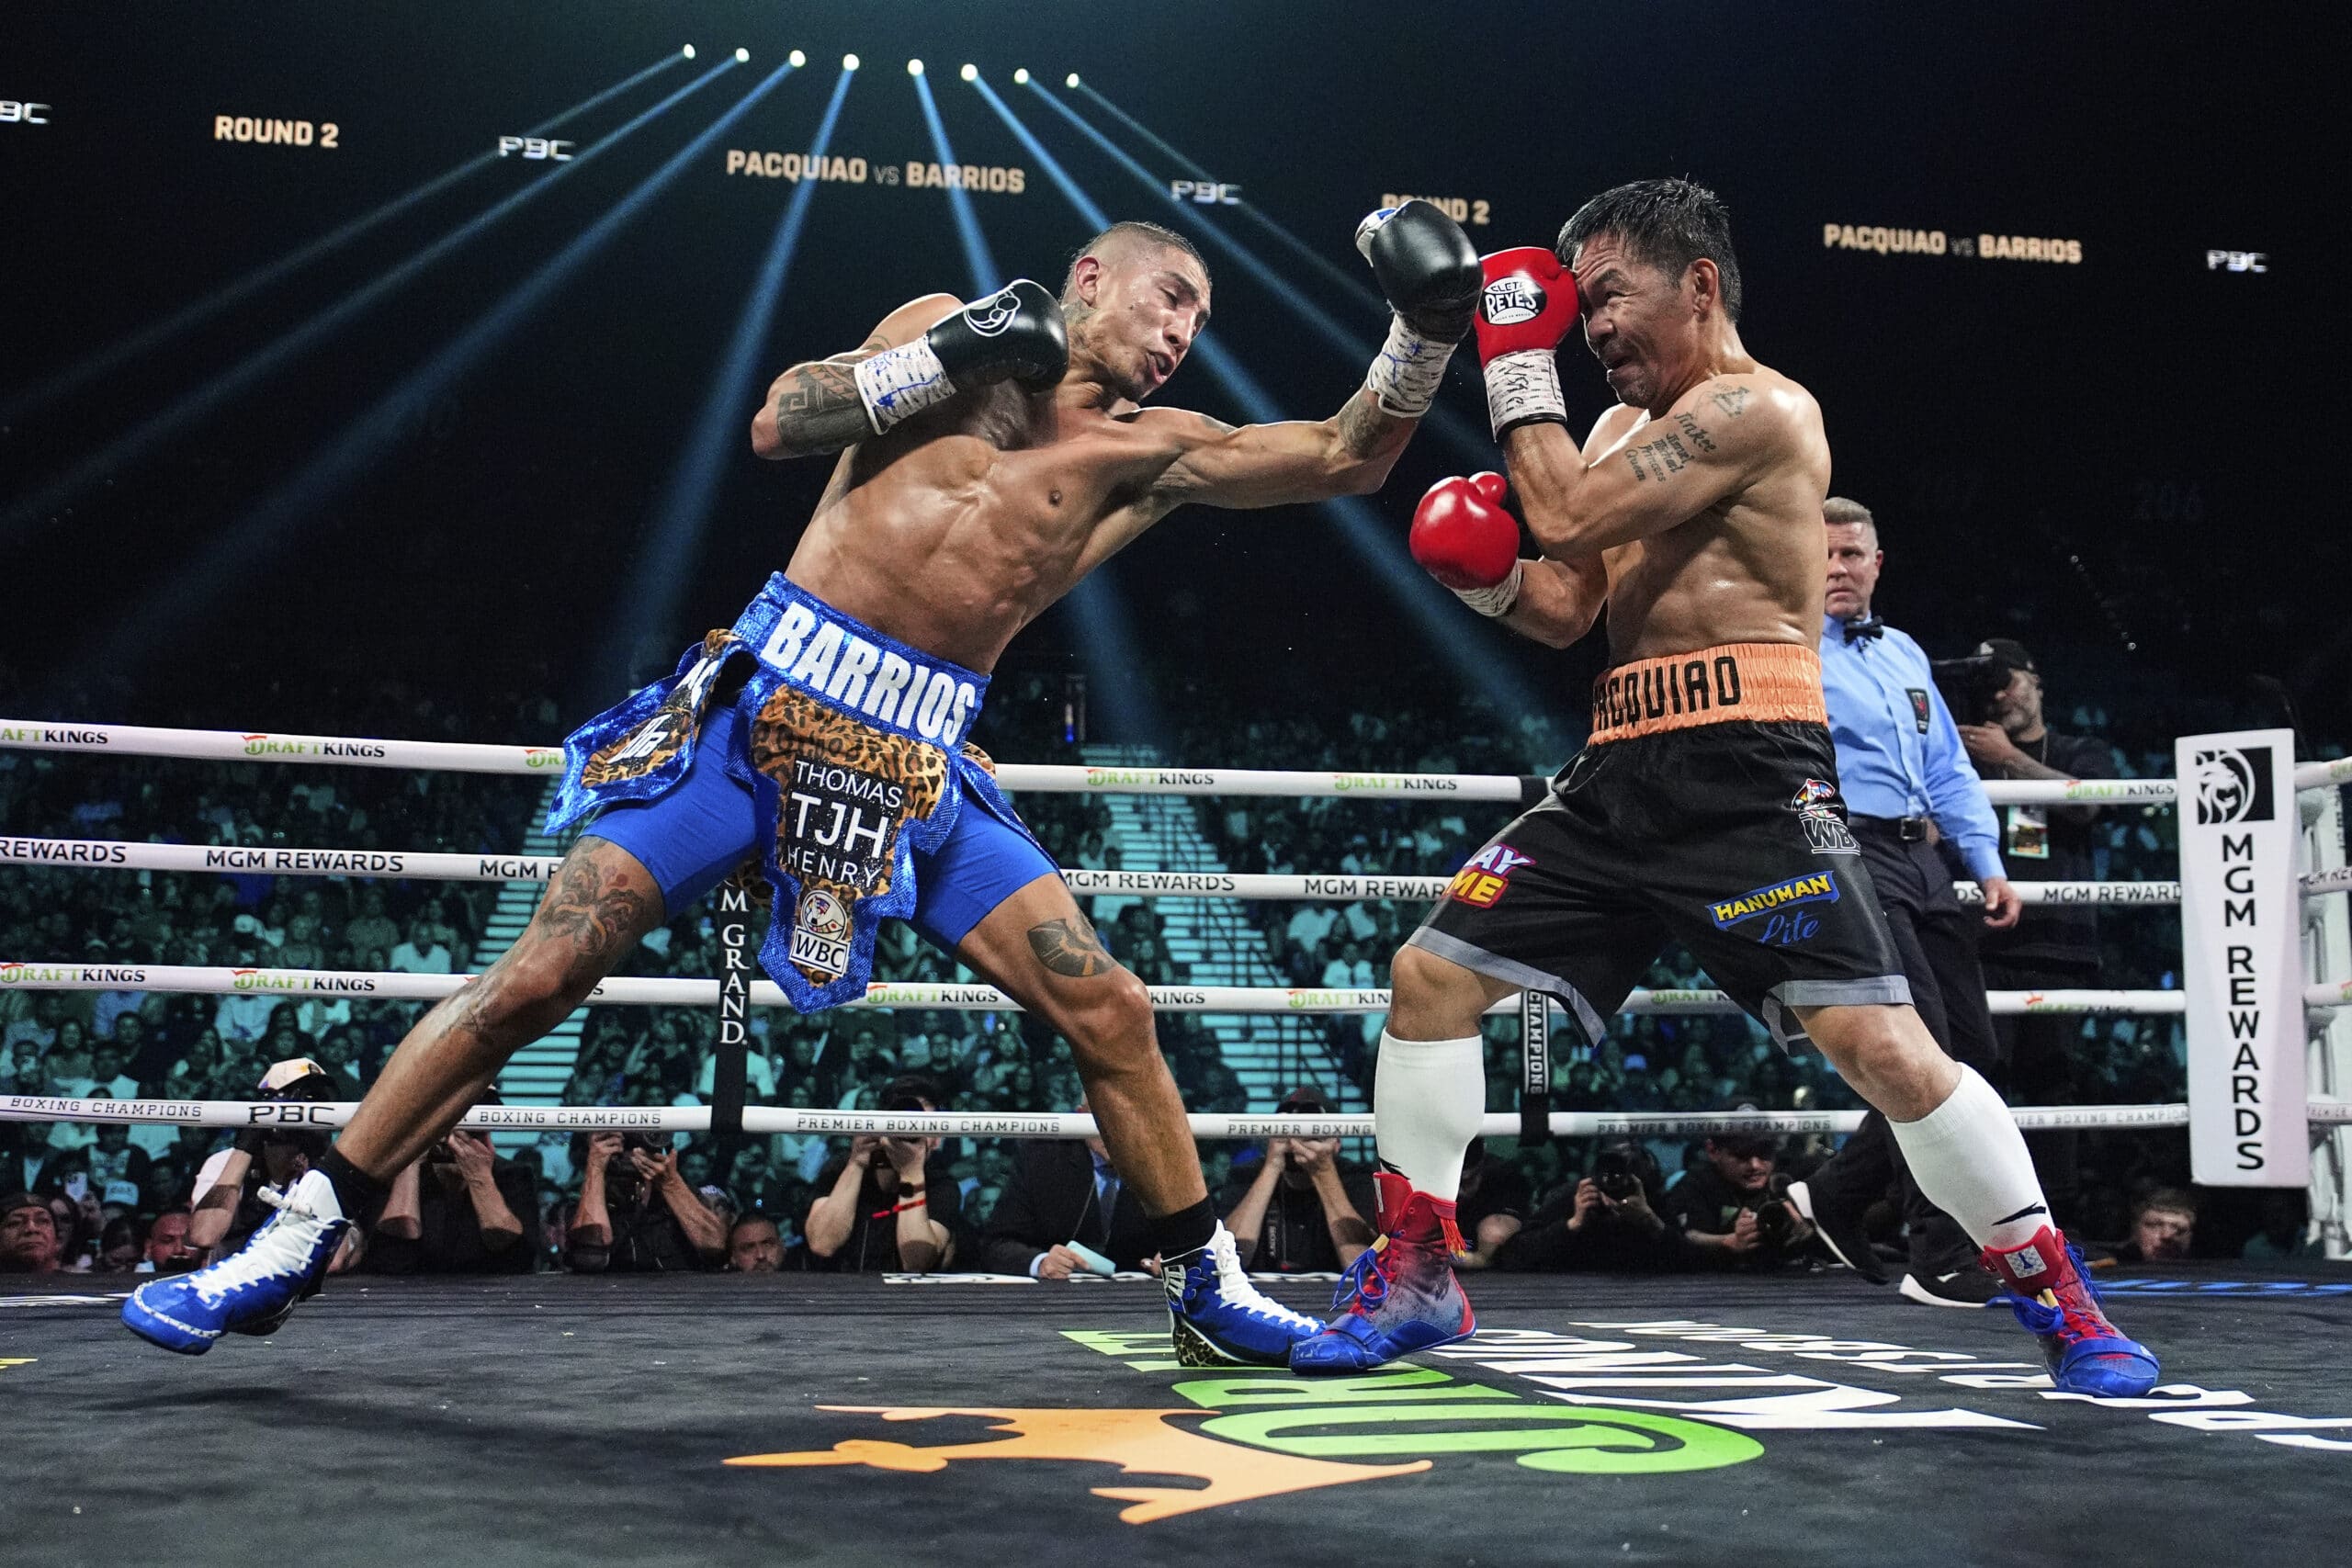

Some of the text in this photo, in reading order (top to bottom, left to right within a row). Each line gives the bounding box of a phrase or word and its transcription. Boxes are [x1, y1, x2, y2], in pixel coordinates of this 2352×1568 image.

[0, 100, 53, 125] BC
[214, 115, 339, 148] ROUND 2
[498, 135, 575, 161] PBC
[727, 149, 867, 184] PACQUIAO
[906, 161, 1025, 194] BARRIOS
[1170, 180, 1242, 205] PBC
[1472, 199, 1491, 225] 2
[1823, 223, 1947, 256] PACQUIAO
[1979, 233, 2083, 265] BARRIOS
[1485, 290, 1537, 323] REYES
[759, 601, 976, 747] BARRIOS
[1594, 655, 1742, 731] ACQUIAO
[2, 727, 108, 745] AFTKINGS
[243, 739, 386, 758] DRAFTKINGS
[795, 760, 903, 809] THOMAS
[1087, 772, 1215, 786] DRAFTKINGS
[1335, 776, 1458, 792] DRAFTKINGS
[791, 792, 889, 860] TJH
[1801, 818, 1861, 850] WB
[0, 840, 127, 864] REWARDS
[206, 850, 403, 872] MGM REWARDS
[1464, 844, 1532, 875] AY
[480, 859, 537, 879] MGM
[786, 844, 884, 888] HENRY
[1118, 873, 1237, 891] REWARDS
[1305, 878, 1445, 898] MGM REWAR
[2042, 884, 2181, 902] MGM REWARD
[1713, 874, 1833, 921] HANUMAN
[794, 932, 846, 969] WBC
[1, 967, 146, 984] DRAFTKINGS
[232, 973, 376, 992] DRAFTKINGS
[866, 987, 999, 1004] DRAFTKINGS
[1149, 991, 1206, 1005] KINGS
[1288, 991, 1390, 1008] DRAFTKIN
[2222, 832, 2265, 1171] MGM REWARDS
[1528, 991, 1544, 1095] CHAMPIONS
[10, 1097, 202, 1118] BOXING CHAMPIONS
[247, 1105, 336, 1126] PBC
[479, 1111, 547, 1123] BOXING
[556, 1111, 662, 1125] CHAMPIONS
[2116, 1109, 2188, 1122] CHAMPION
[797, 1117, 1060, 1133] PREMIER BOXING CHAMPIONS
[1227, 1123, 1372, 1135] PREMIER BOXING
